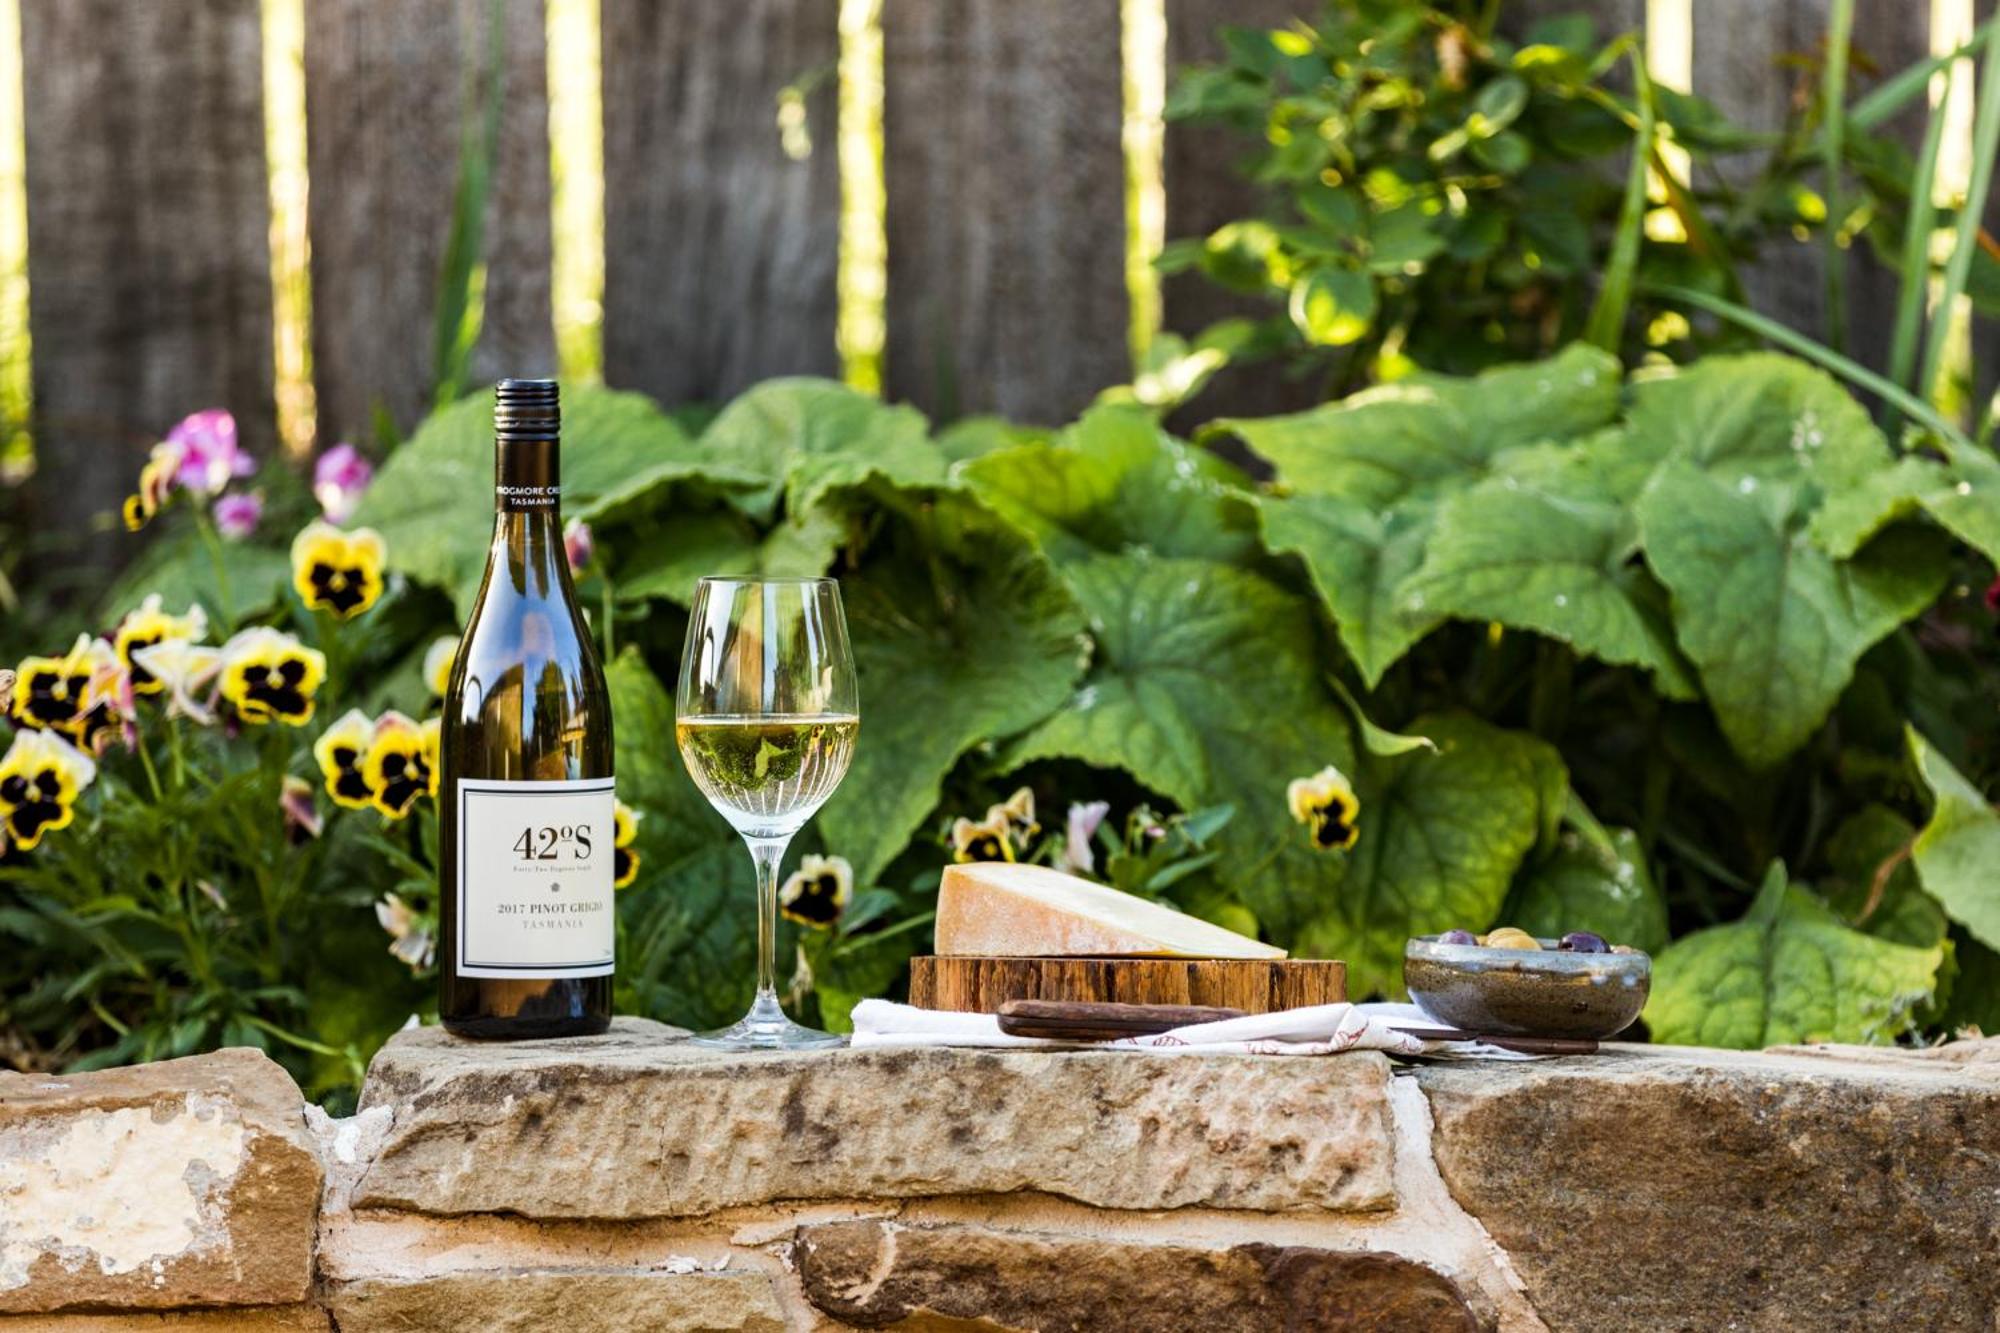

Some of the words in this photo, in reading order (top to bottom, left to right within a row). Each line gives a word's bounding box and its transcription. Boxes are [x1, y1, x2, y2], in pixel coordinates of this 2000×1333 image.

[498, 904, 525, 914] 2017
[530, 904, 566, 914] PINOT
[523, 920, 584, 929] TASMANIA
